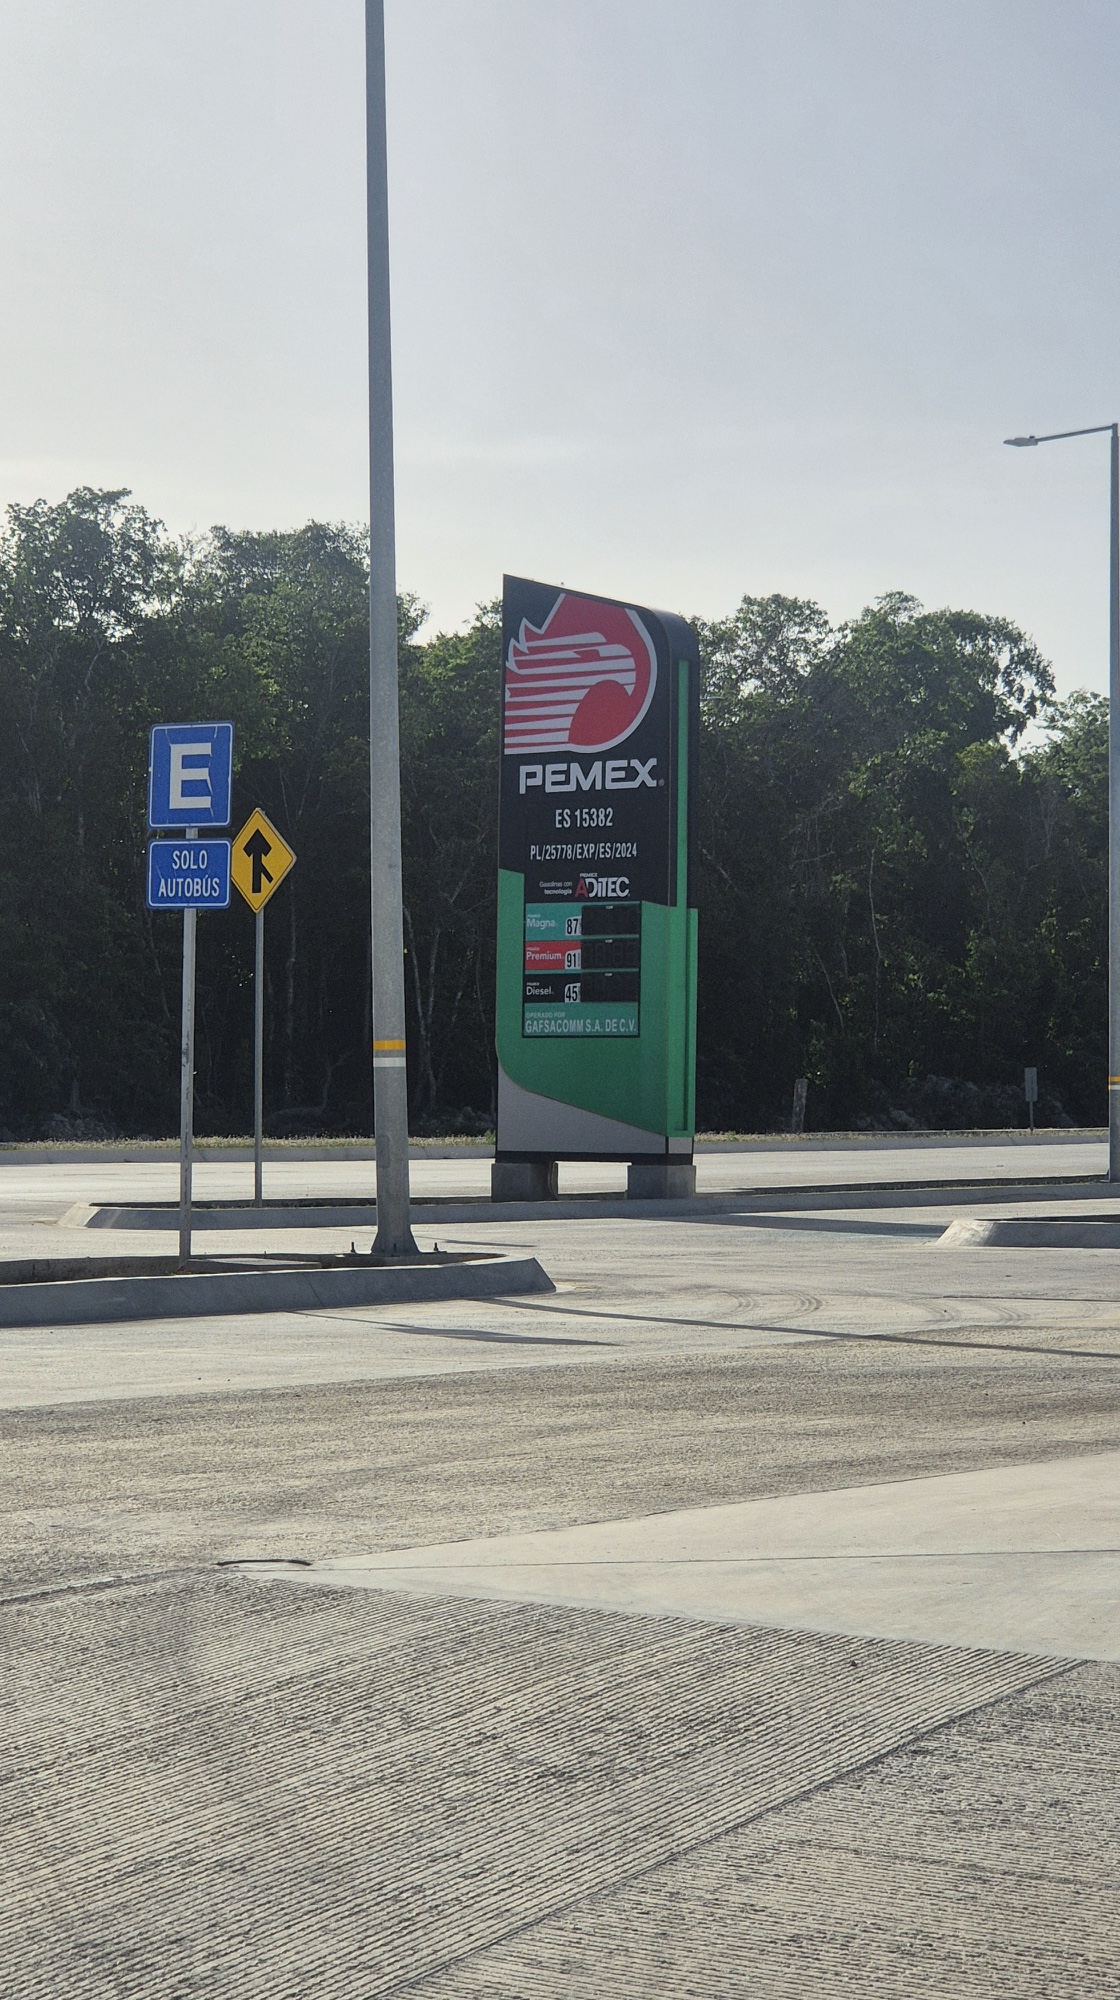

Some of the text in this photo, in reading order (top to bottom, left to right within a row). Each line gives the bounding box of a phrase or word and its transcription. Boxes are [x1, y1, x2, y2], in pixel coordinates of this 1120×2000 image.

[169, 743, 212, 809] E
[519, 758, 658, 795] PEMEX
[555, 807, 614, 828] ES 15382
[530, 842, 638, 861] PL/25778/EXP/ES/2024
[172, 850, 208, 870] SOLO
[158, 875, 220, 897] AUTOBÚS
[526, 918, 556, 930] Magna
[566, 919, 579, 935] 87
[526, 951, 562, 960] Premium
[566, 953, 577, 968] 91
[526, 986, 552, 995] Diesel
[565, 986, 578, 1002] 45
[525, 1019, 637, 1033] GAFSACOMM S.A. DE C.V.
